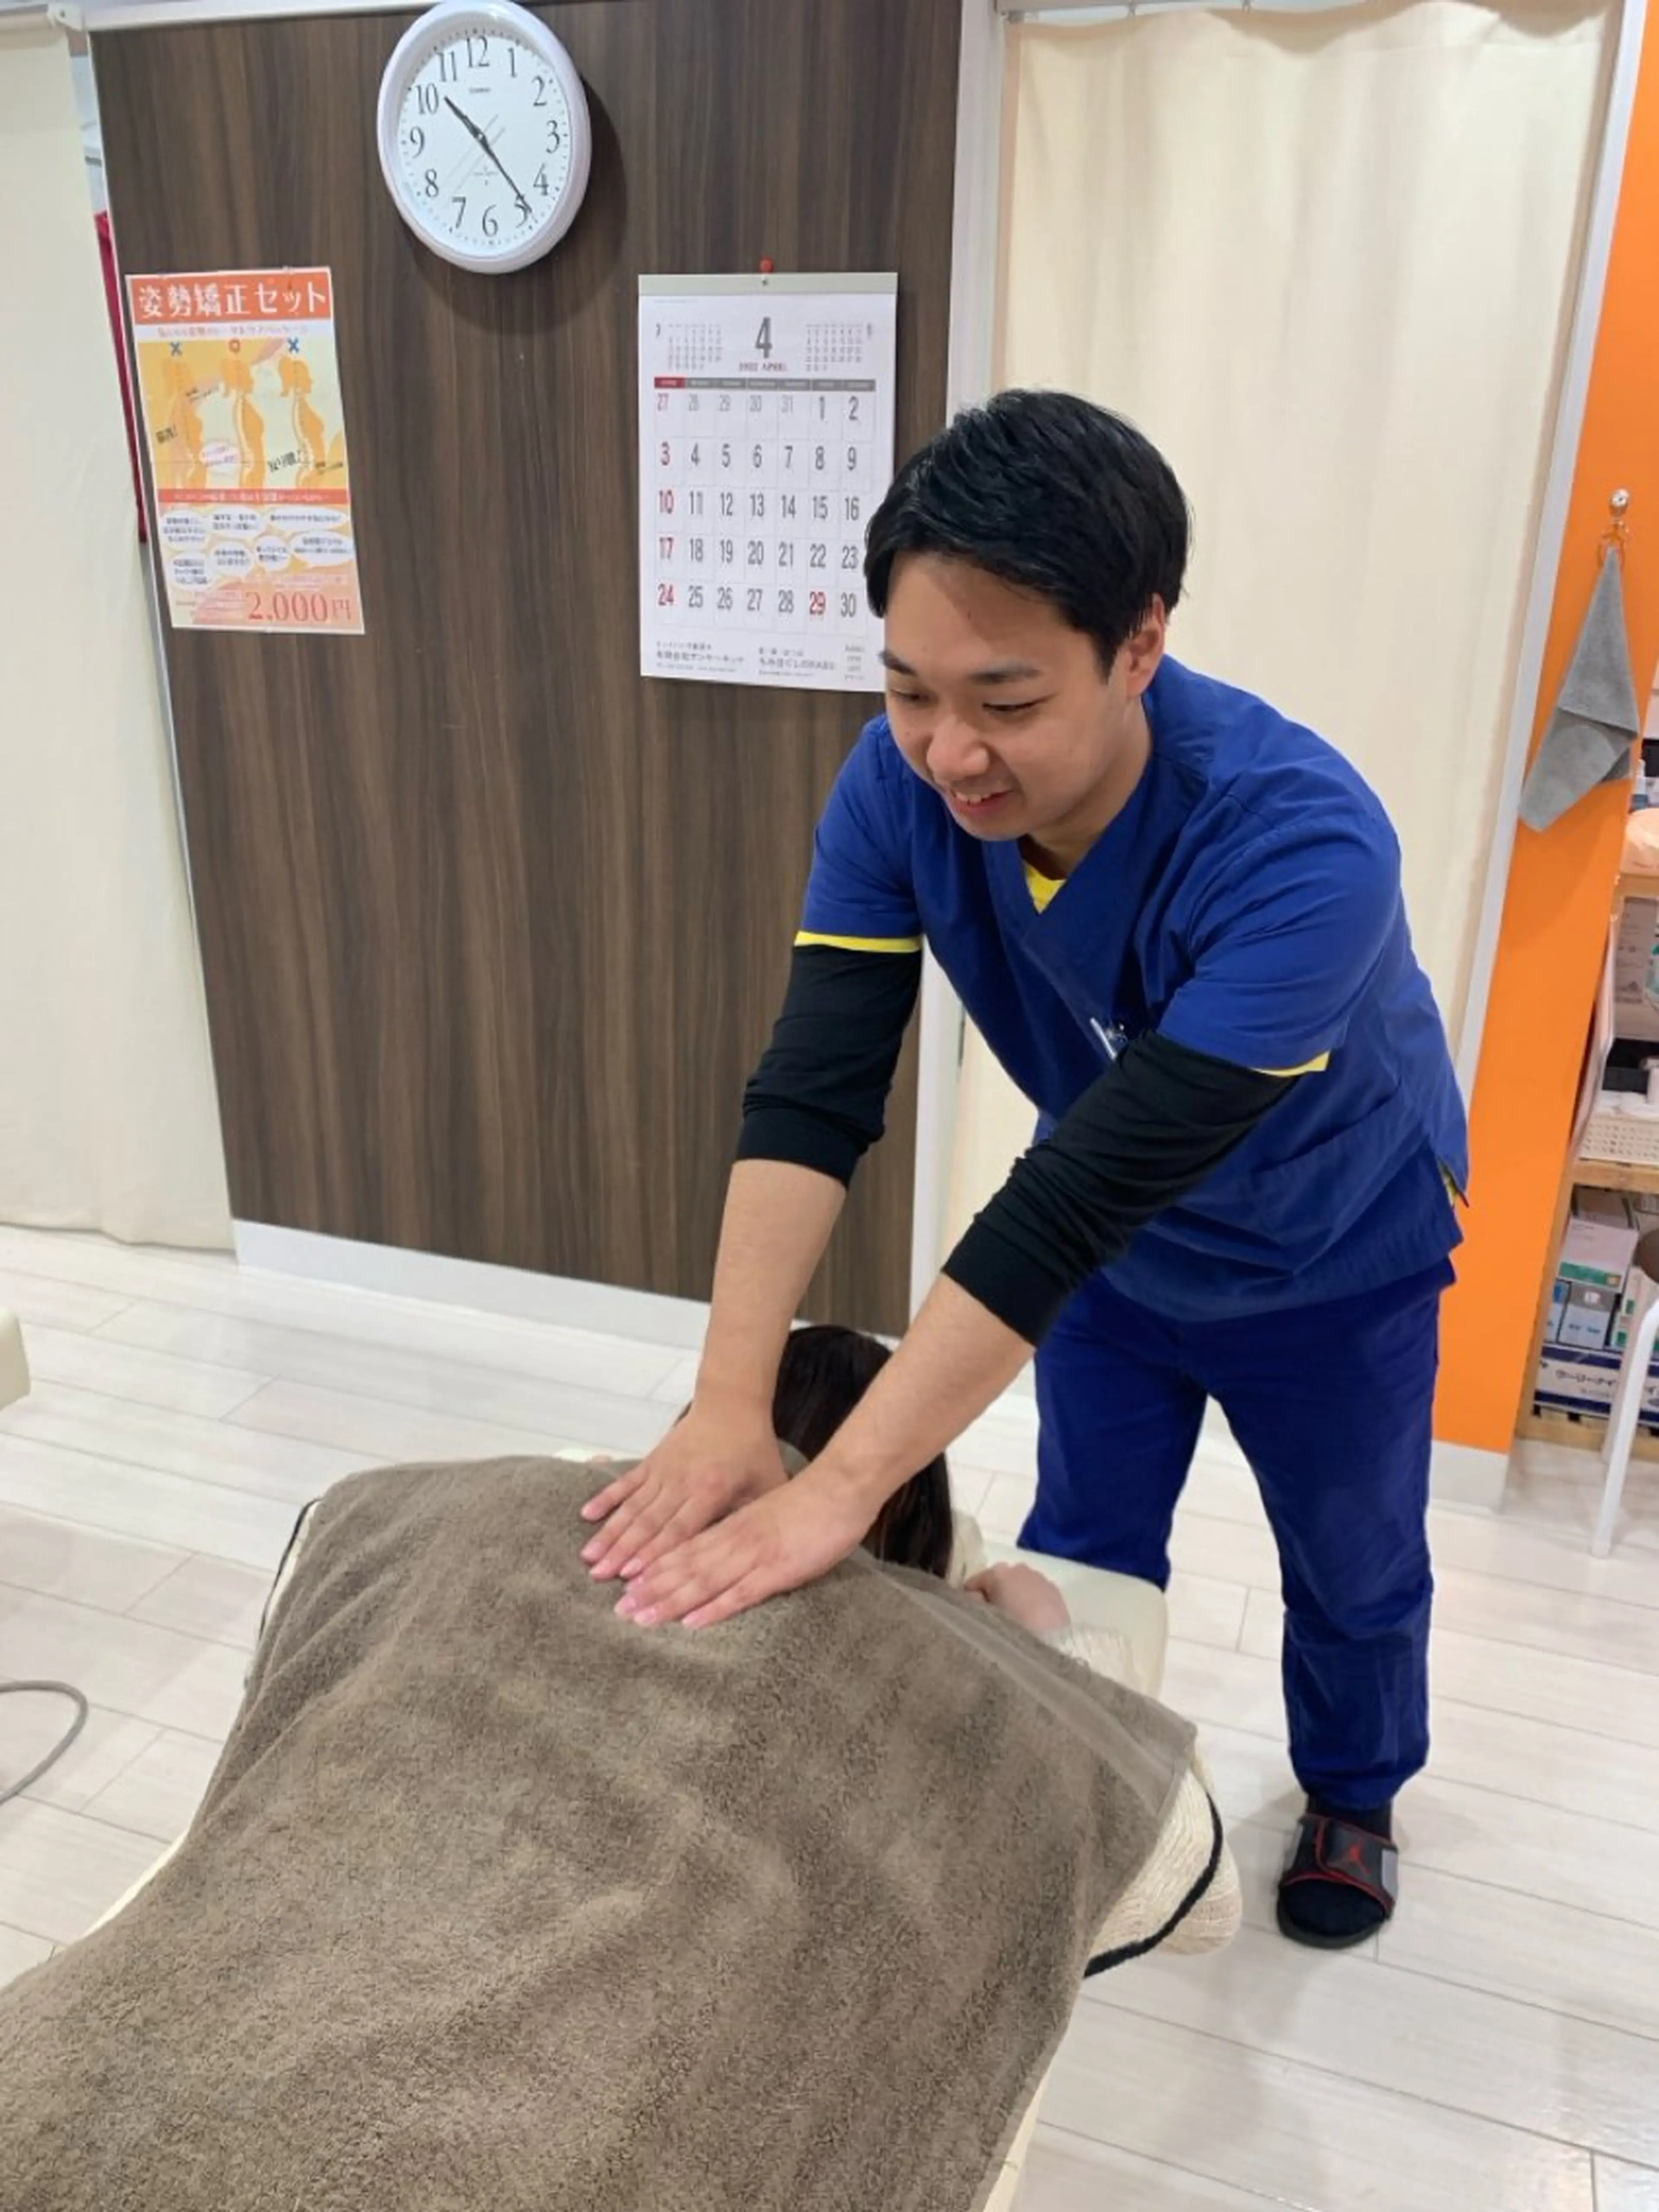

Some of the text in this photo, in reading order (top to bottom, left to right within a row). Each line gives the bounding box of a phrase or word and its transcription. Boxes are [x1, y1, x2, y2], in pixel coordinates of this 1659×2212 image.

[438, 50, 457, 82] 11
[466, 36, 490, 68] 12
[508, 48, 517, 78] 1
[415, 83, 439, 114] 10
[533, 76, 547, 106] 2
[410, 127, 425, 157] 9
[546, 120, 560, 153] 3
[425, 169, 439, 197] 8
[533, 164, 549, 196] 4
[452, 197, 466, 229] 7
[482, 205, 498, 236] 6
[139, 282, 325, 318] 姿勢矯正セット
[755, 317, 772, 359] 4
[819, 396, 825, 420] 1
[849, 396, 858, 421] 2
[661, 442, 856, 470] 3 4 5 6 7 8 9
[659, 489, 859, 521] 10 11 12 13 14 15 16
[659, 537, 858, 569] 17 18 19 20 21 22 23
[245, 592, 351, 622] 2,000円
[658, 583, 856, 617] 24 25 26 27 28 29 30
